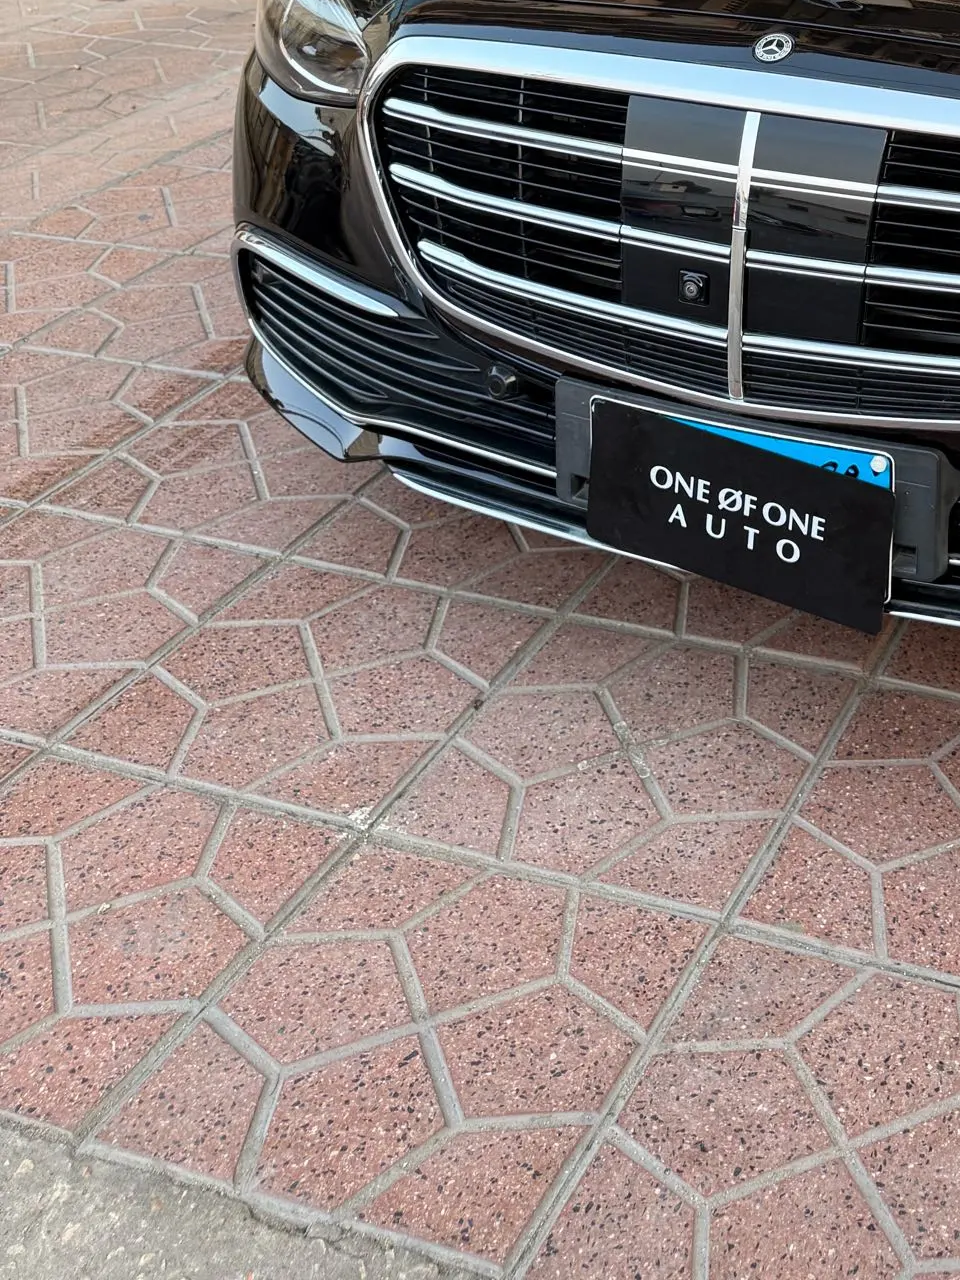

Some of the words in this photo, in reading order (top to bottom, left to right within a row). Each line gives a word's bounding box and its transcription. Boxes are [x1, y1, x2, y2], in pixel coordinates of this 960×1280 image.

[650, 465, 711, 504] ONE
[762, 501, 826, 541] ONE
[667, 503, 801, 564] AUTO
